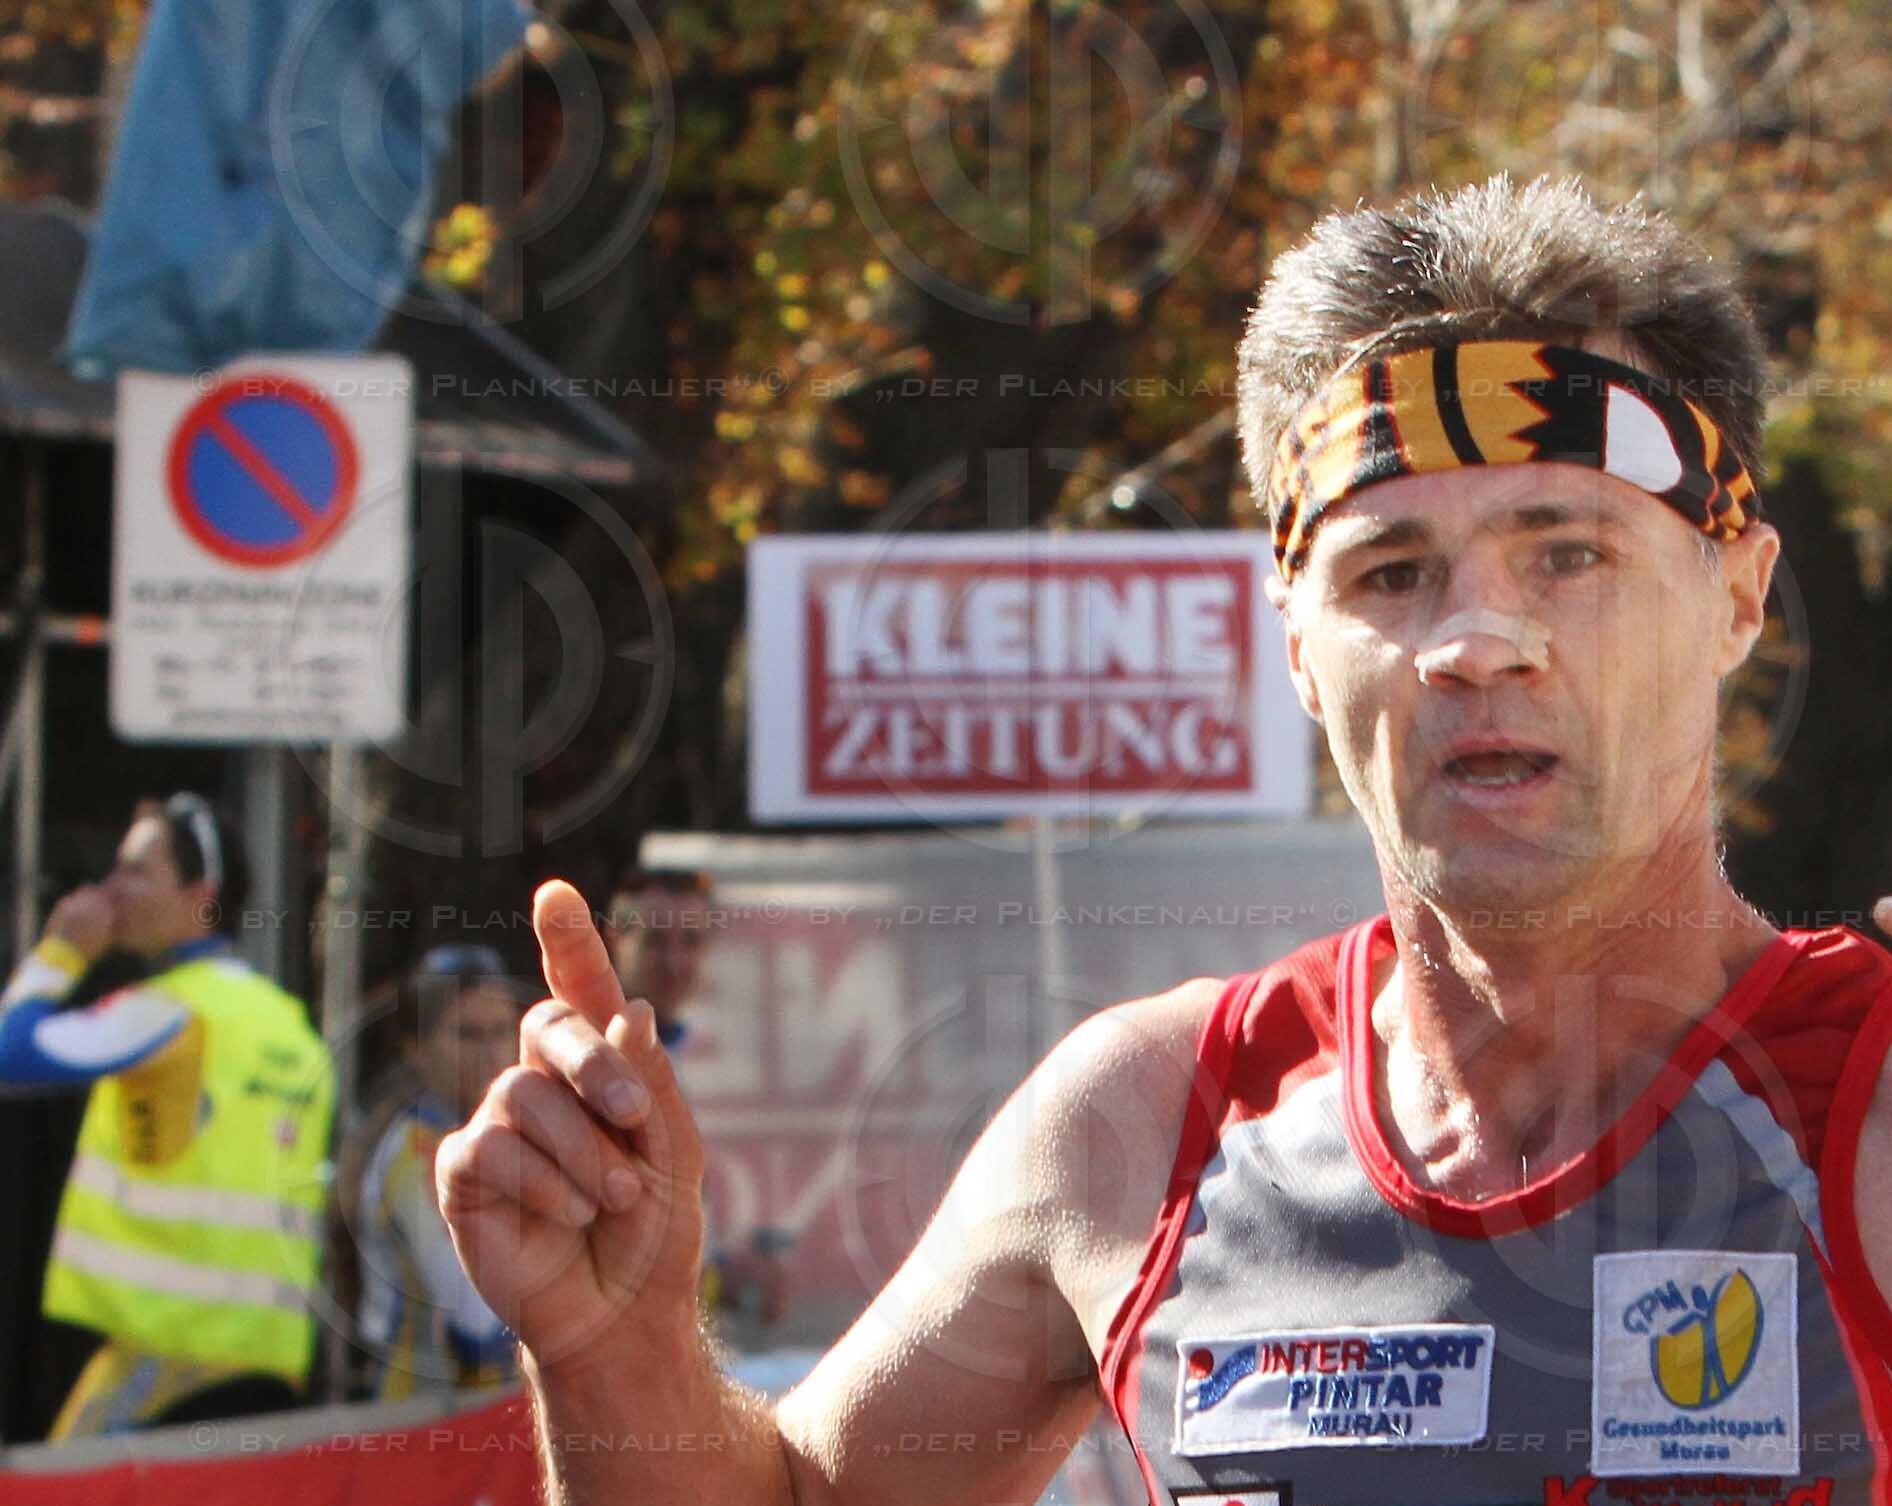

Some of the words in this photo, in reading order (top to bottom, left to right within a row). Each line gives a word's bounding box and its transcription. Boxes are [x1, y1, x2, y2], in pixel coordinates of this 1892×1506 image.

[823, 573, 1237, 676] KLEINE
[821, 702, 1238, 779] ZEITUNG
[1260, 1334, 1484, 1374] INTERSPORT
[1289, 1371, 1444, 1411] PINTAR
[1308, 1412, 1412, 1437] MURAU
[1602, 1416, 1787, 1441] Gesundheitspark
